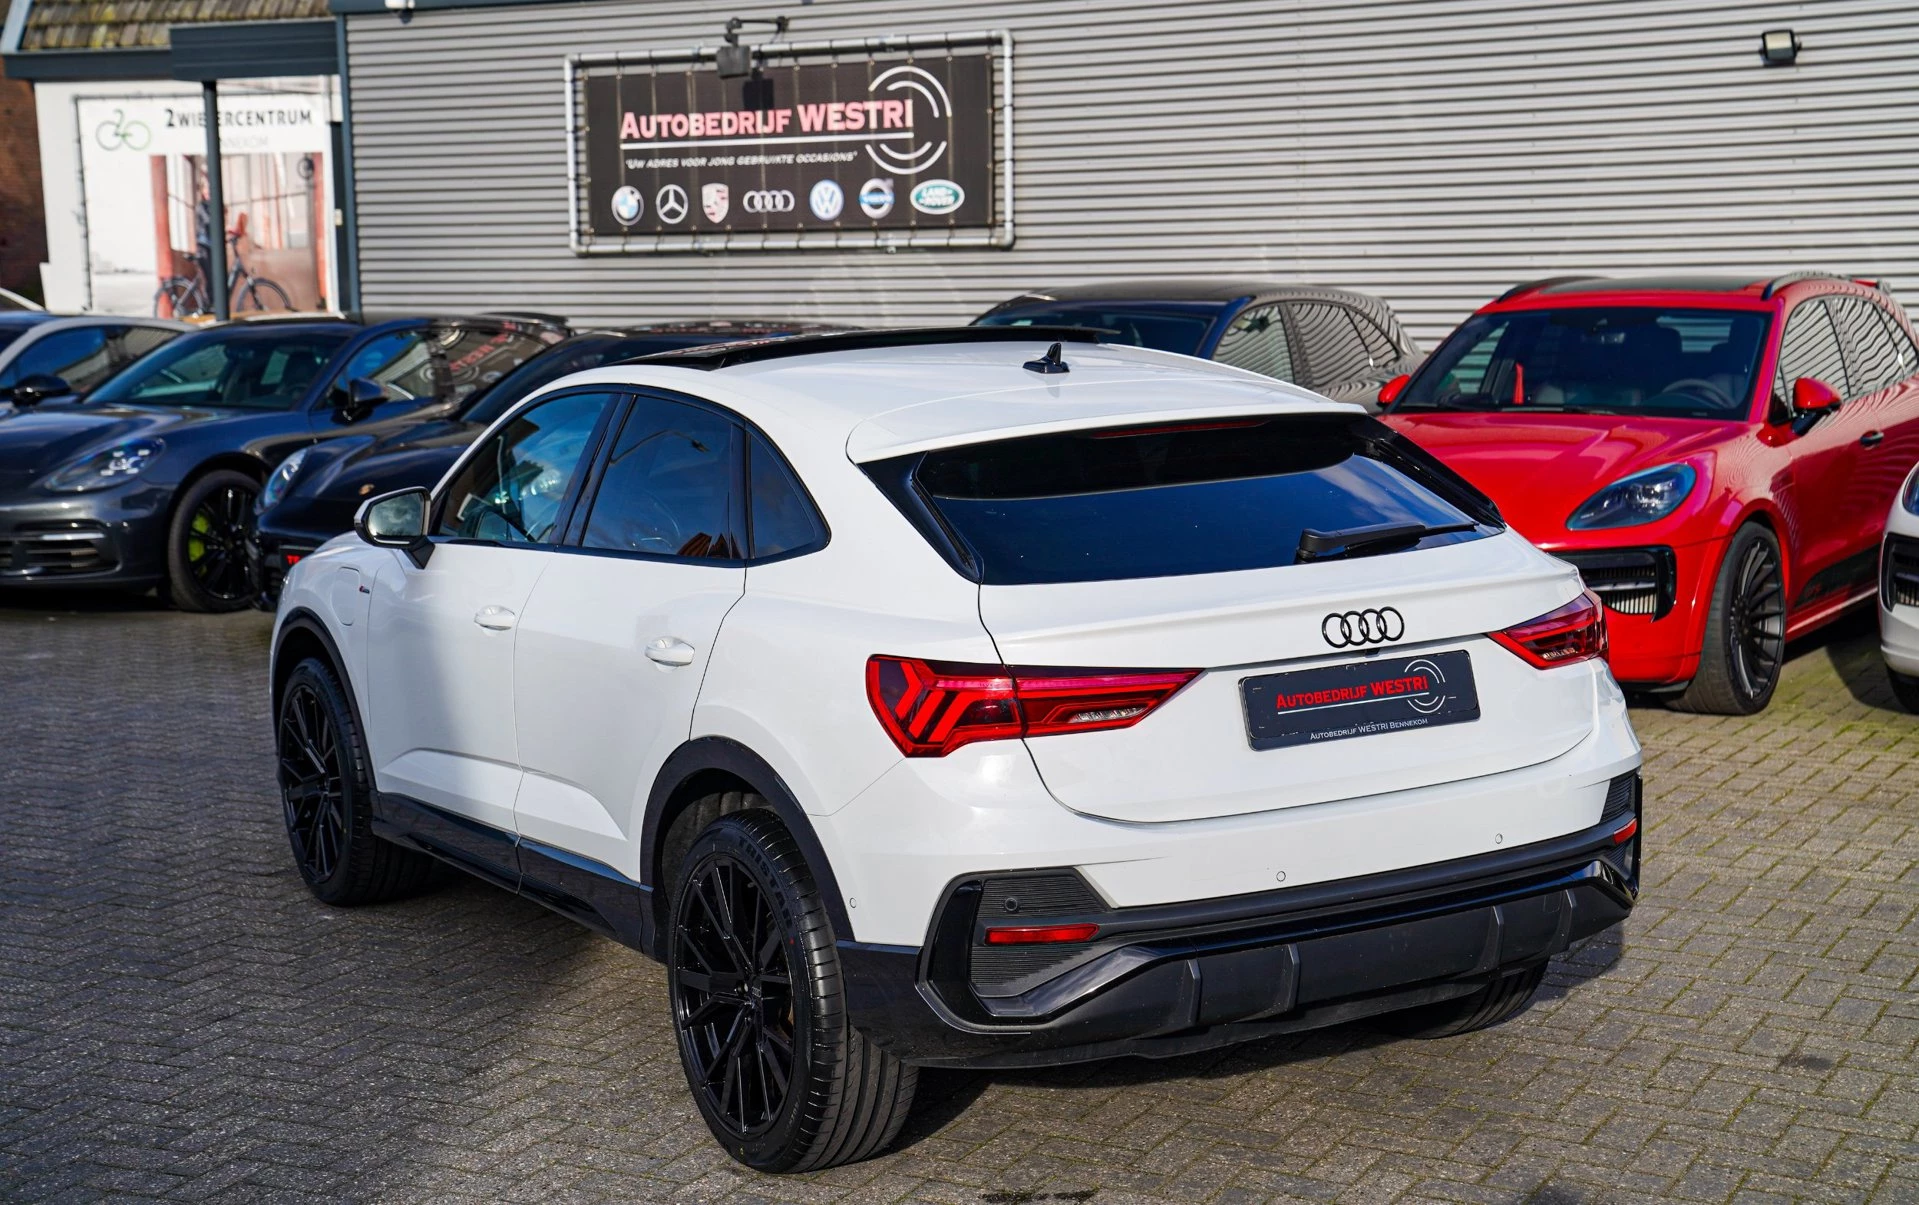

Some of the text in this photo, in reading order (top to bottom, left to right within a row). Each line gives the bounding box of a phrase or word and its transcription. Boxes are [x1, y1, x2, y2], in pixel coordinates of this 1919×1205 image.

[164, 108, 312, 128] 2WIEERCENTRUM
[619, 98, 914, 140] AUTOBEDRIJF WESTRI
[646, 157, 679, 169] ADRES
[680, 156, 708, 168] VOOR
[707, 155, 736, 167] JONG
[1275, 675, 1429, 710] AUTOBEDRIJF WESTRI
[1310, 718, 1429, 741] AUTOBEDRIJF WESTRI BENNEKOM
